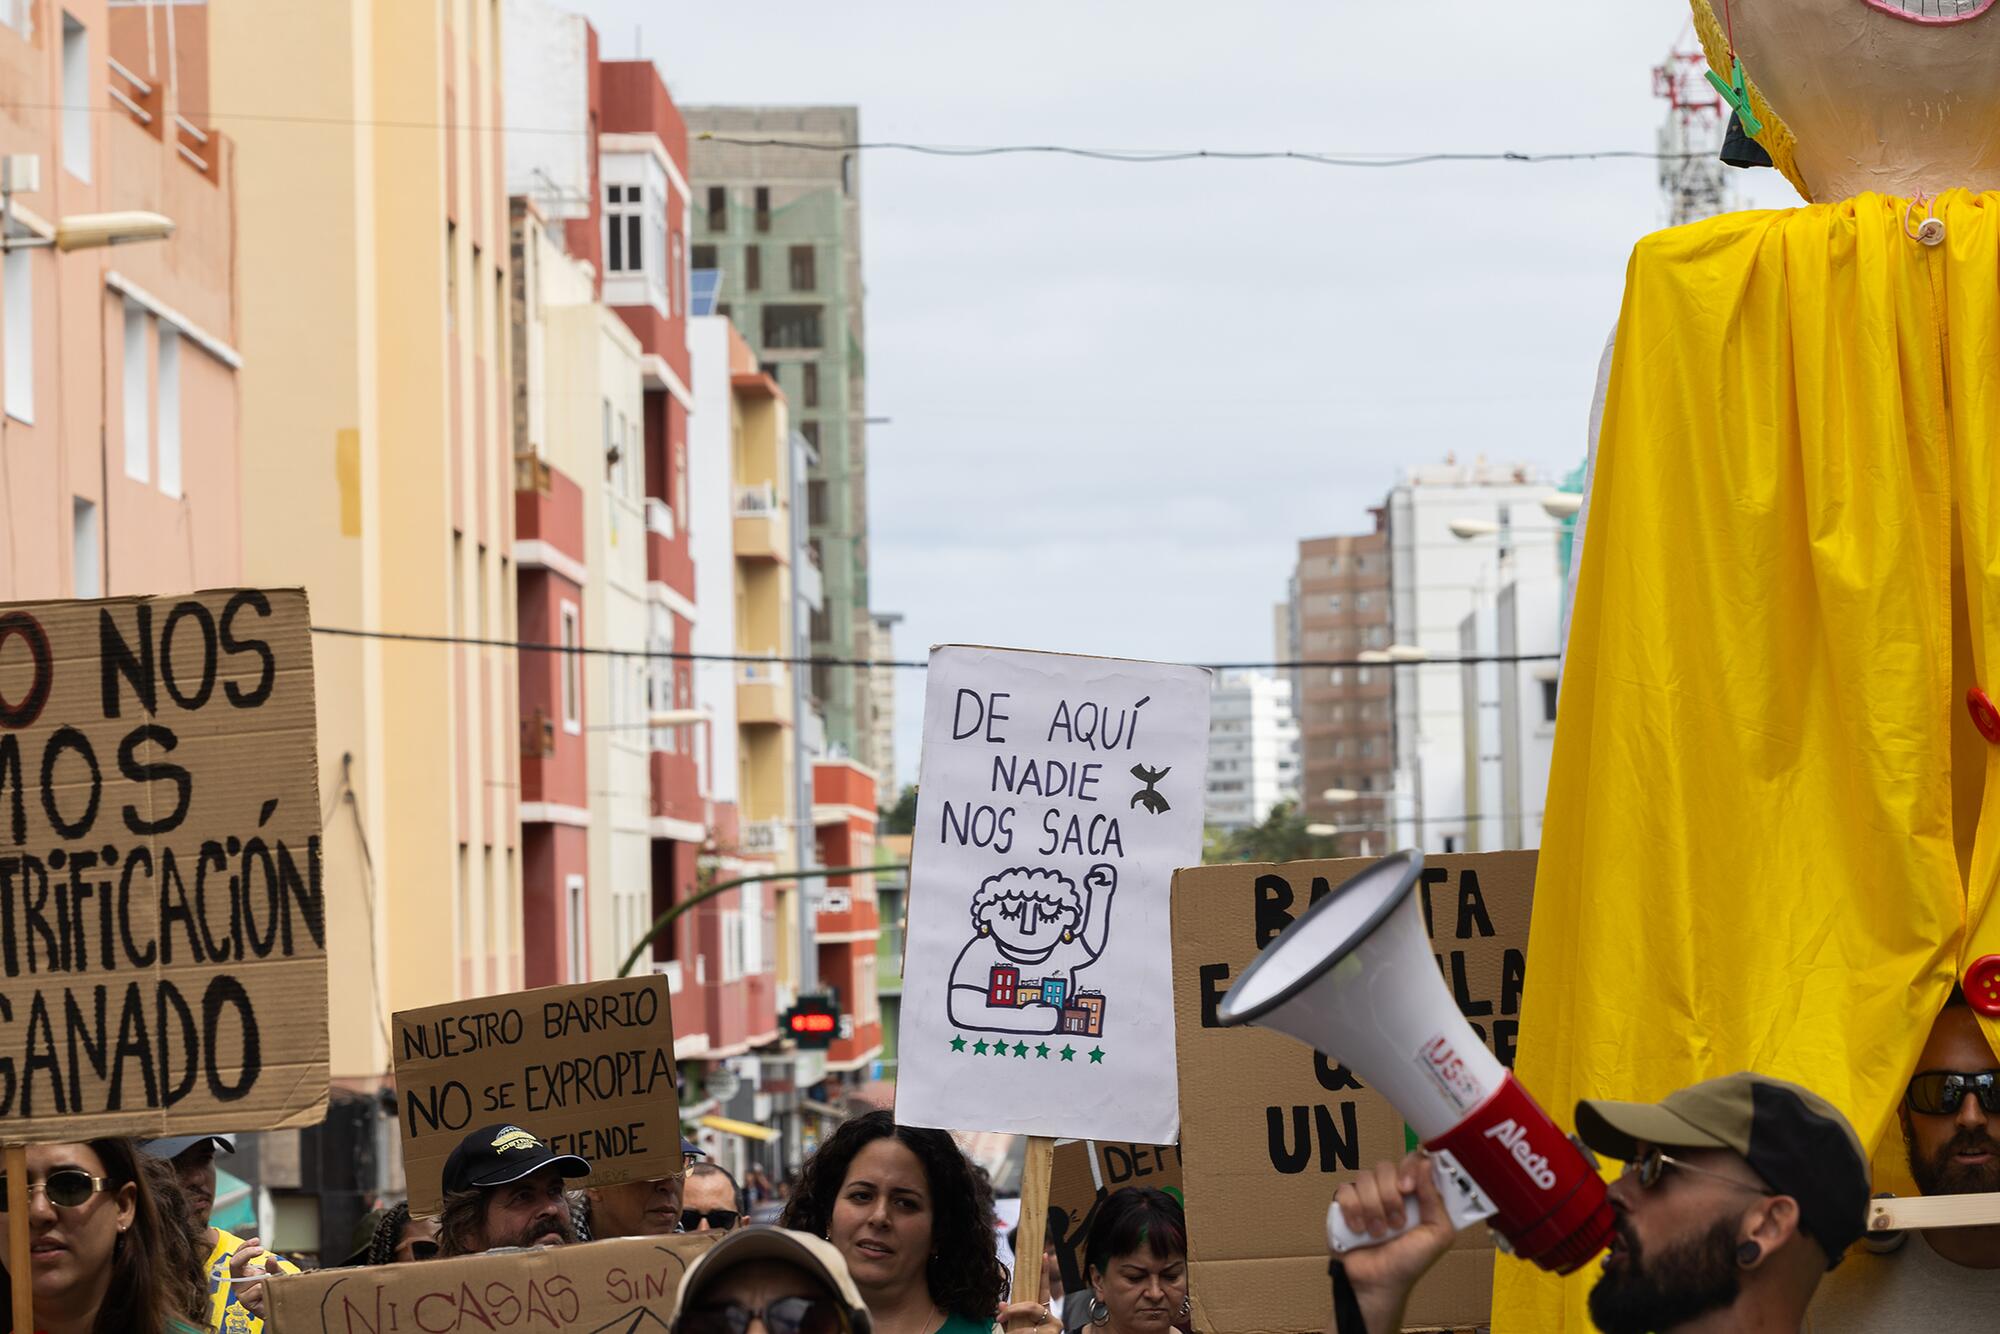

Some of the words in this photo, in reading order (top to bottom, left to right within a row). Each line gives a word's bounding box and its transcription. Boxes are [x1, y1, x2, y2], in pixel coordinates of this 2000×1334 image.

[99, 588, 276, 719] NOS
[953, 688, 1010, 743] DE
[1048, 696, 1150, 751] AQUÍ
[992, 755, 1102, 801] NADIE
[941, 801, 1016, 854] NOS
[1038, 808, 1124, 857] SACA
[403, 1009, 523, 1060] NUESTRO
[544, 987, 658, 1039] BARRIO
[407, 1080, 472, 1137] NO
[483, 1082, 515, 1112] SE
[525, 1048, 674, 1112] EXPROPIA
[1266, 1101, 1360, 1174] UN
[1484, 1118, 1557, 1191] Alecto
[414, 1275, 580, 1334] CASAS
[606, 1268, 668, 1304] SIN
